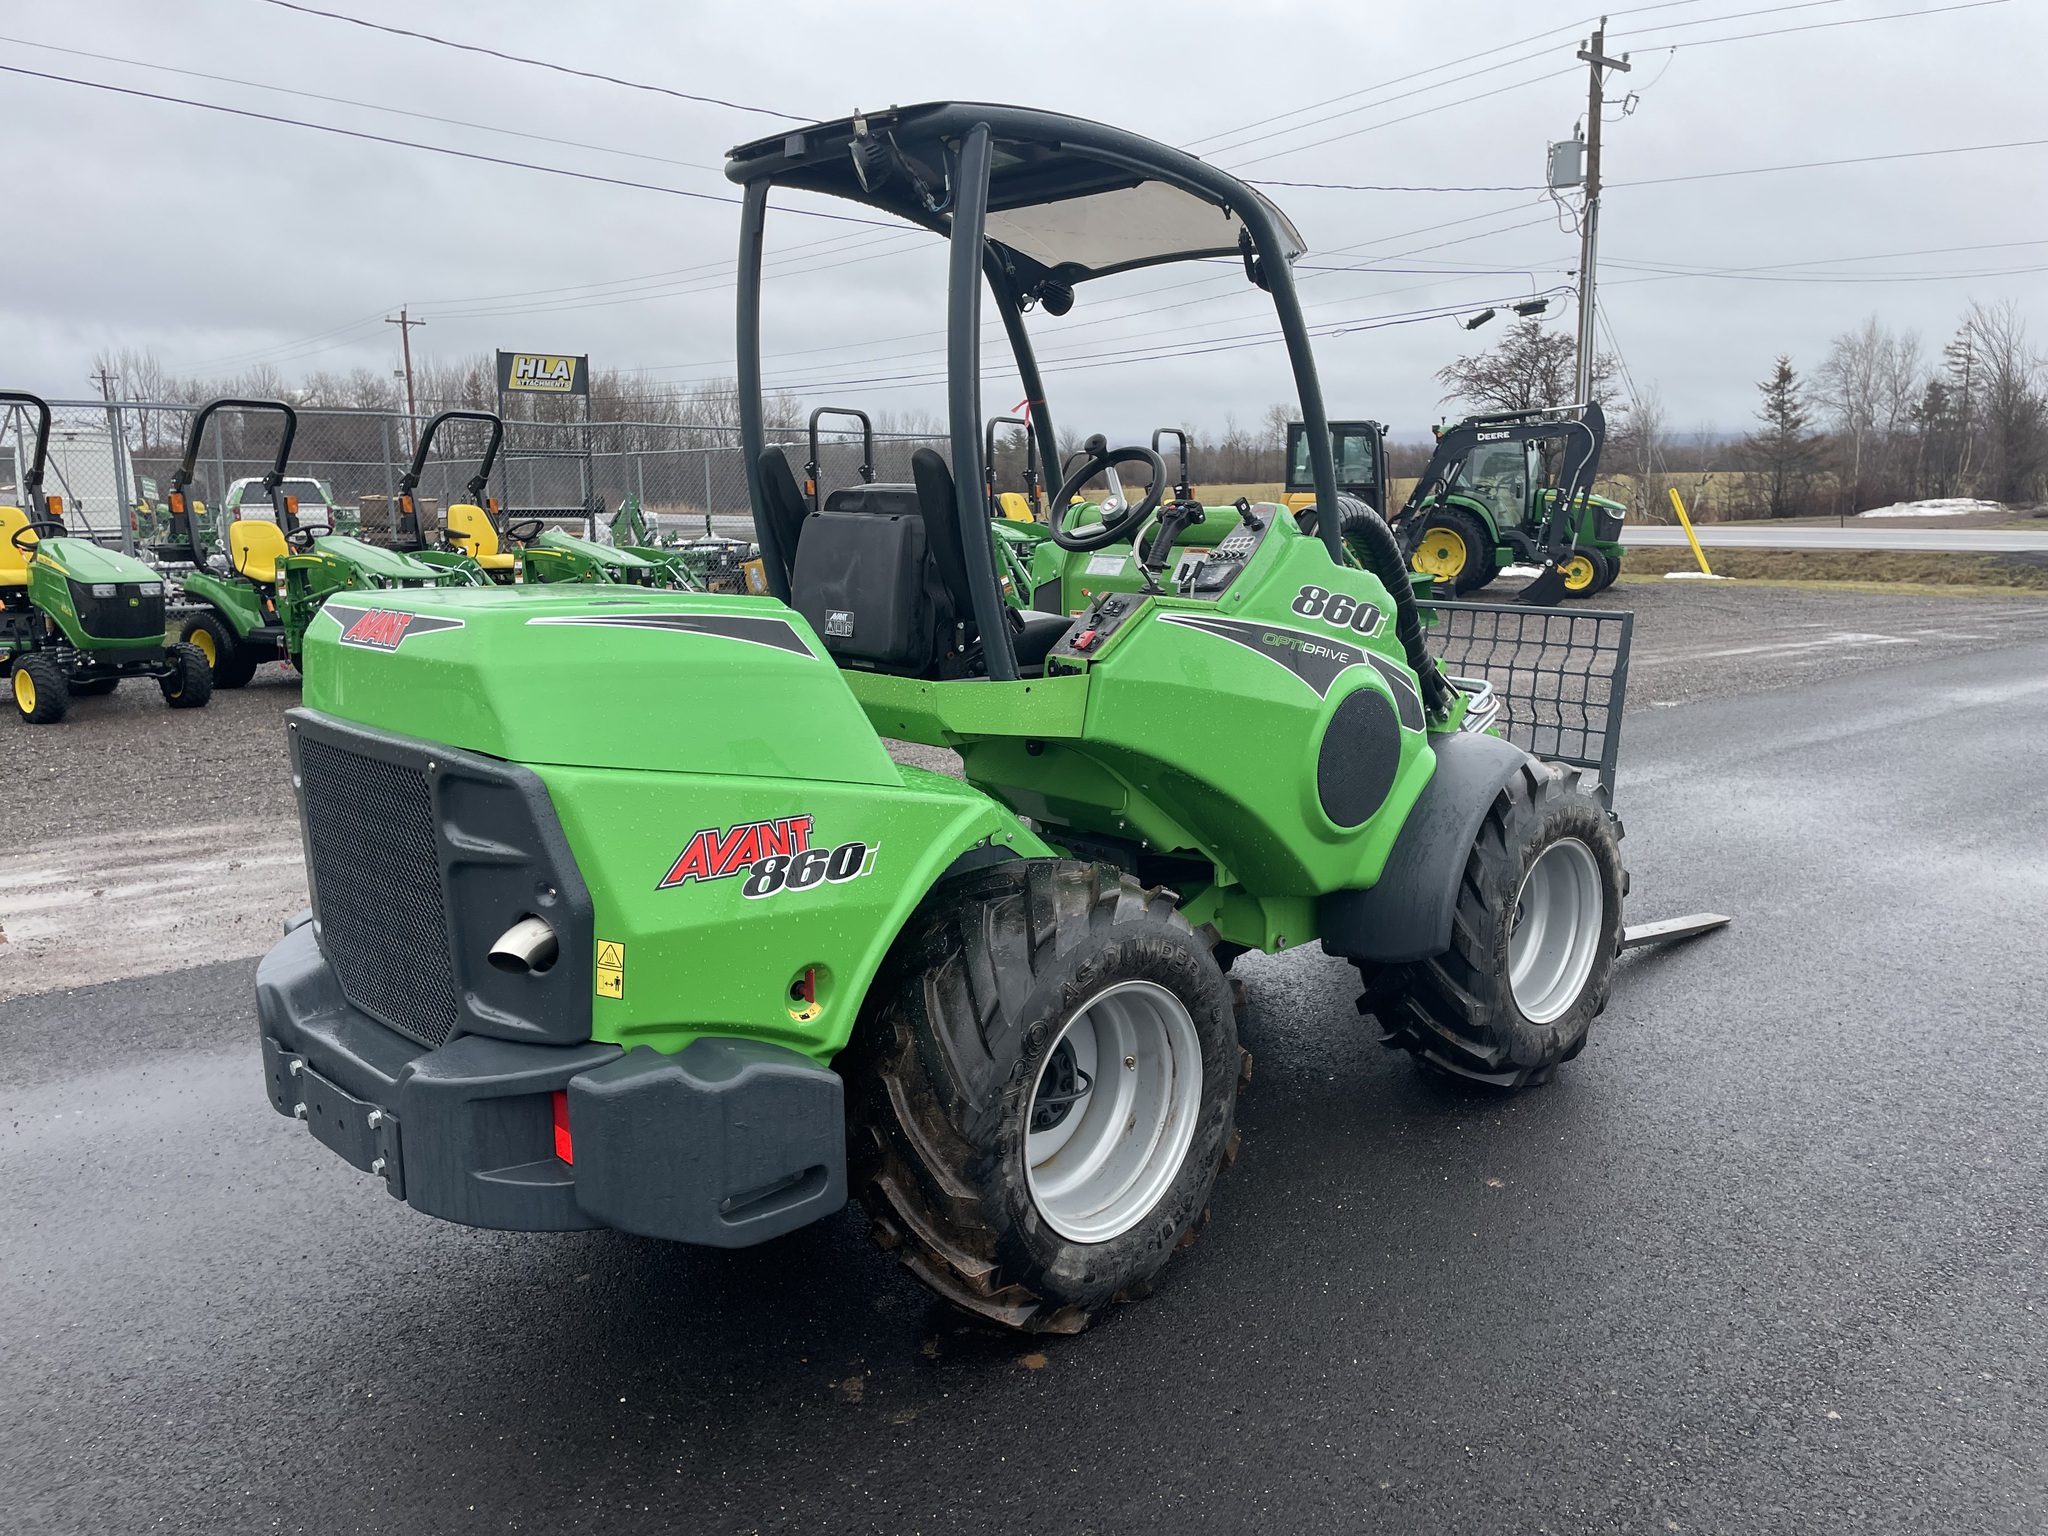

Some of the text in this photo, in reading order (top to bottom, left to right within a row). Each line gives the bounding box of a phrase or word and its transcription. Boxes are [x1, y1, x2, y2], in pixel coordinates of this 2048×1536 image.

[516, 358, 571, 381] HLA
[516, 380, 569, 388] ATTACHMENTS
[1477, 431, 1510, 441] DEERE
[343, 607, 415, 647] AVANT
[830, 612, 848, 621] AVANT
[654, 813, 816, 891] AVANT
[1060, 957, 1099, 1001] AS
[1101, 937, 1200, 977] DUMPER
